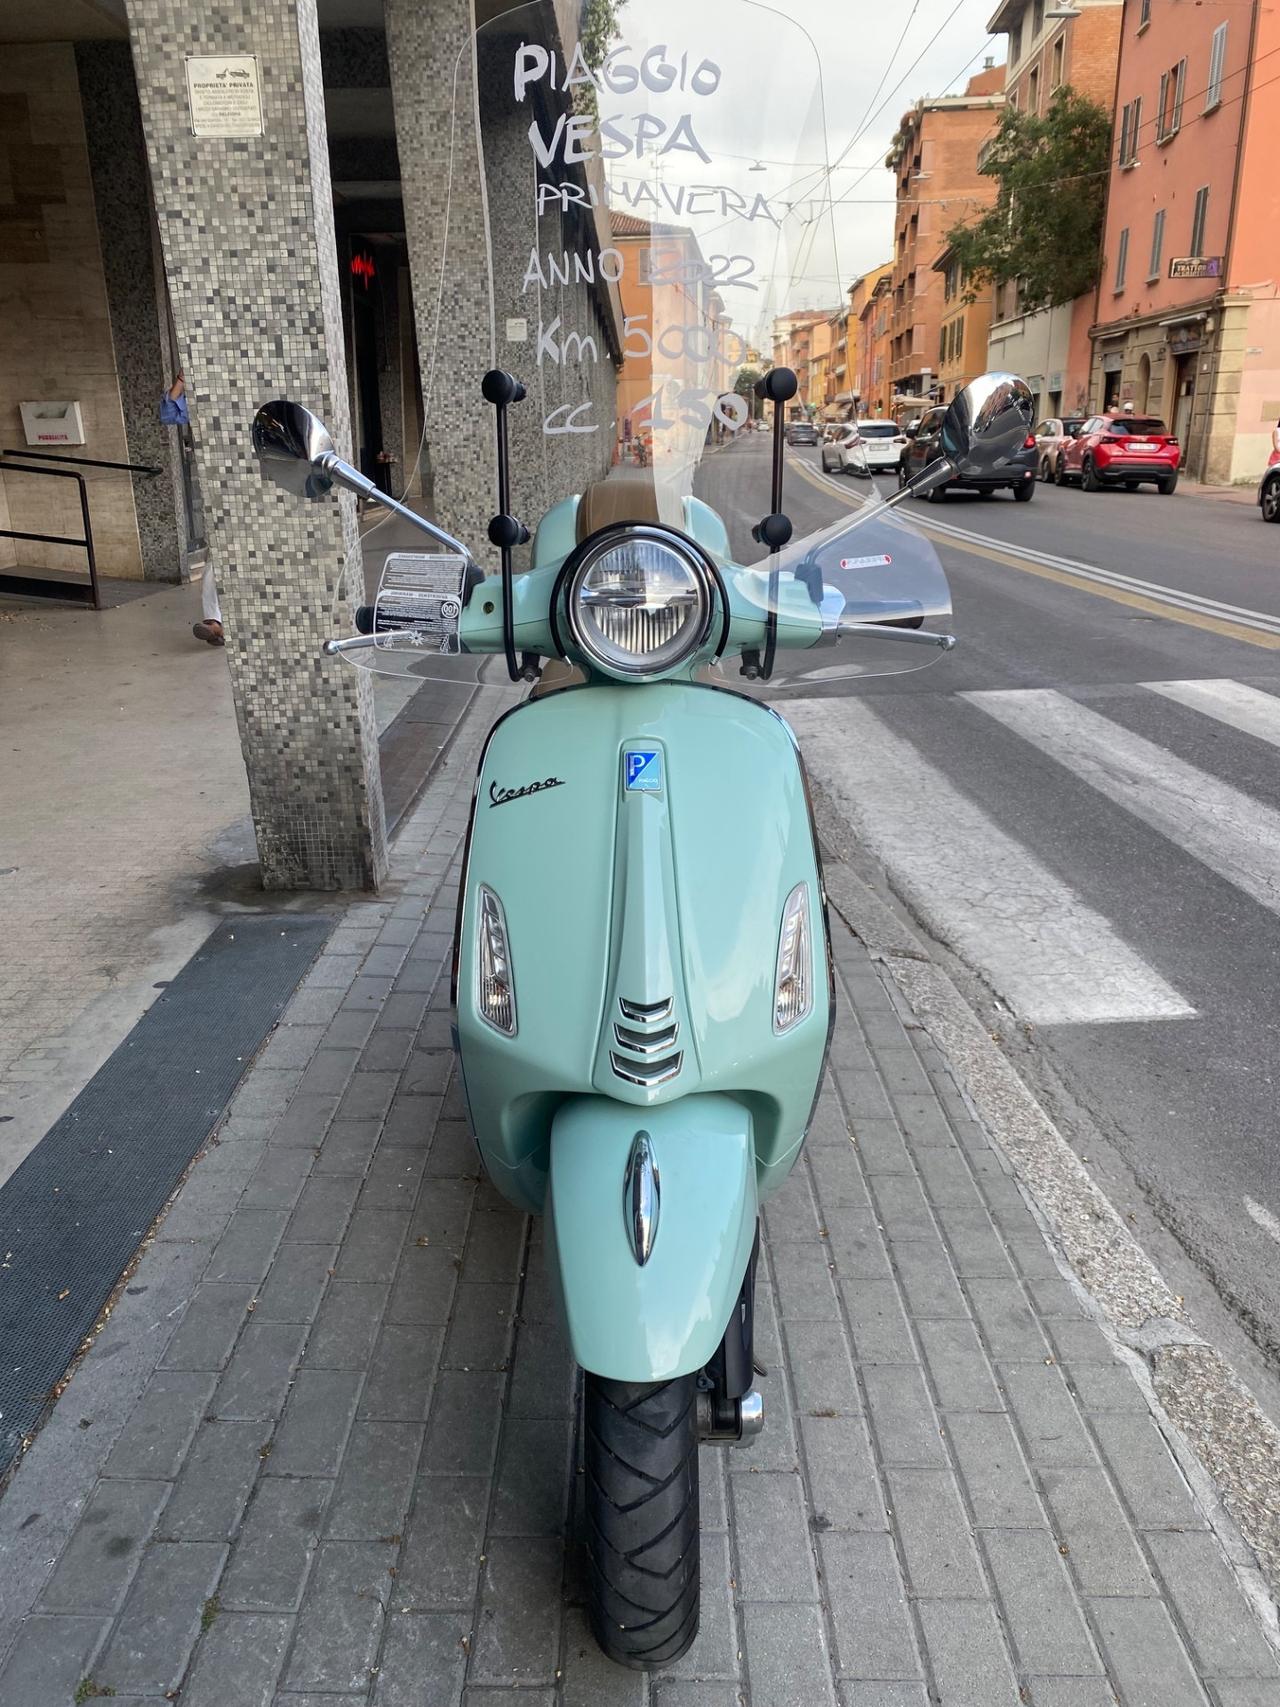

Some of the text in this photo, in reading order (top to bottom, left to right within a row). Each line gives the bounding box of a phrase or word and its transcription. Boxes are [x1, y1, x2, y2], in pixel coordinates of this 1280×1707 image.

[514, 41, 722, 102] PIAGGIO
[528, 113, 712, 169] VESPA
[537, 181, 782, 230] PRIMAVERA
[522, 247, 625, 293] ANNO
[623, 314, 748, 367] 5000
[631, 383, 749, 431] 150
[629, 754, 647, 777] P
[489, 776, 566, 808] Vespa
